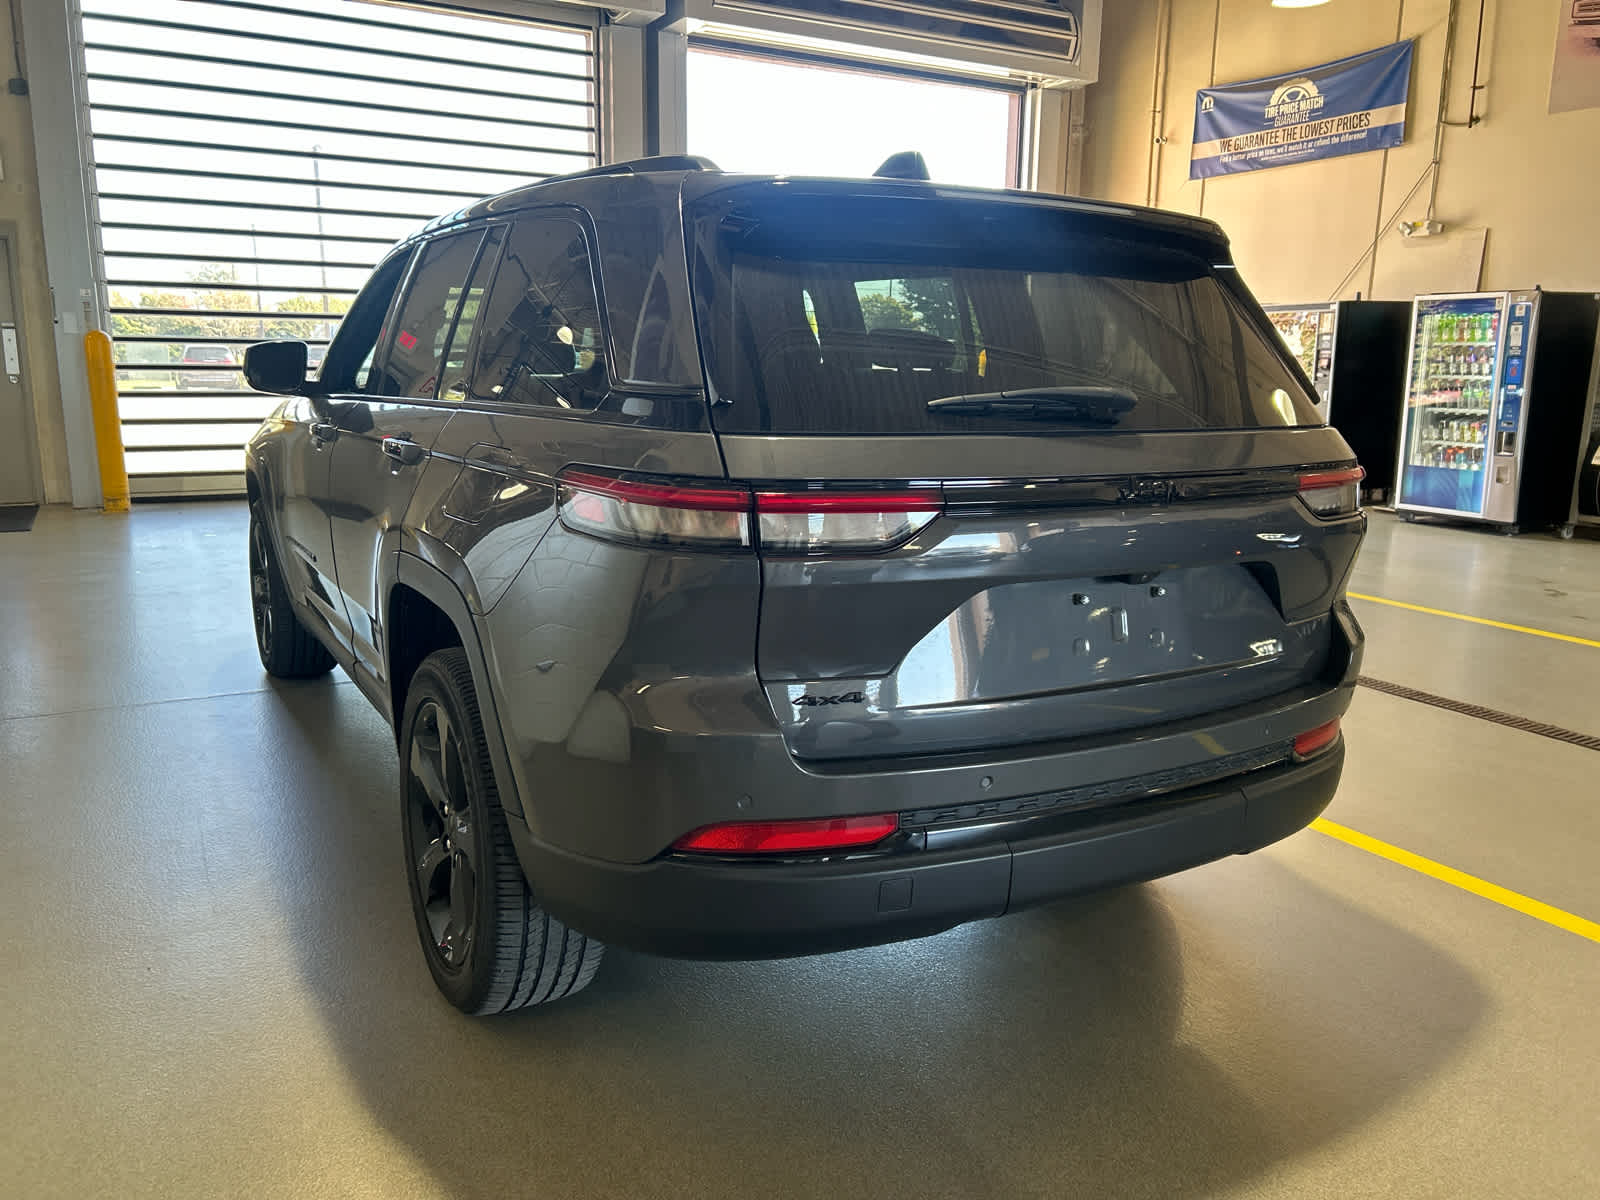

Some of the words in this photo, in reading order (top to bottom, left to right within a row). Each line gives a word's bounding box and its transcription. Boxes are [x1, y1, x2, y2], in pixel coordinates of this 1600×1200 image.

[1264, 106, 1279, 119] TIRE
[1280, 101, 1299, 114] PRICE
[1300, 96, 1323, 111] MATCH
[1274, 111, 1310, 127] GUARANTEE
[1219, 139, 1232, 153] WE
[1233, 130, 1280, 151] GUARANTEE
[1281, 126, 1298, 143] THE
[1299, 119, 1336, 139] LOWEST
[1336, 112, 1371, 132] PRICES
